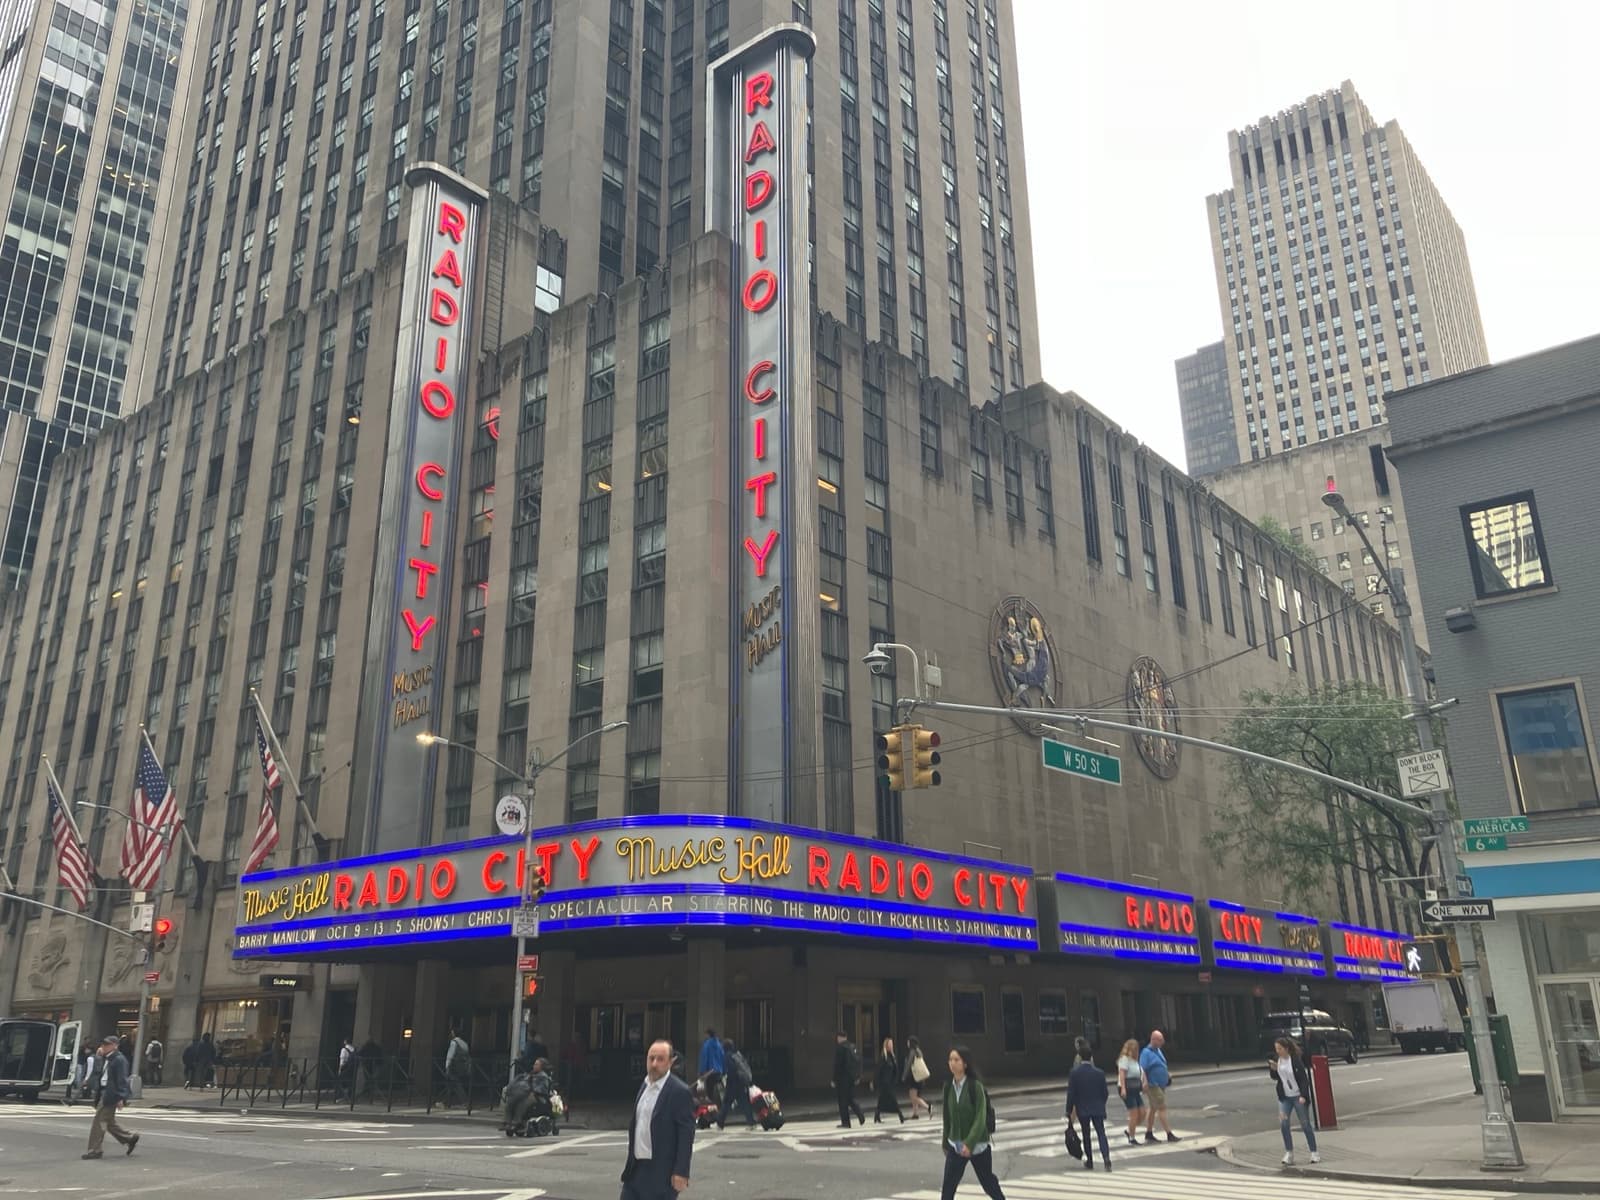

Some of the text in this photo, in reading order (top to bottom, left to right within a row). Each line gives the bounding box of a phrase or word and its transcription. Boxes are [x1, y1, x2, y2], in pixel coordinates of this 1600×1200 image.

[742, 72, 779, 577] RADIO CITY
[401, 202, 466, 651] RADIO CITY
[1063, 750, 1101, 775] W 50 St
[1400, 752, 1441, 767] DON'T BLOCK
[1408, 763, 1436, 774] THE BOX
[1469, 822, 1526, 835] AMERICAS
[1475, 838, 1485, 851] 6
[334, 859, 457, 910] RADIO
[482, 836, 600, 894] CITY
[616, 836, 726, 881] Music
[719, 835, 792, 883] Hall
[808, 845, 934, 901] RADIO
[953, 867, 1029, 914] CITY
[240, 934, 267, 948] BARRY
[272, 929, 317, 945] MANILOW
[326, 925, 349, 940] OCT
[354, 924, 361, 937] 9
[373, 921, 384, 936] 13
[395, 919, 402, 934] 5
[549, 896, 673, 920] SPECTACULAR
[690, 896, 773, 916] STARRING
[782, 899, 805, 919] THE
[813, 903, 850, 922] RADIO
[857, 909, 883, 925] CITY
[890, 912, 950, 932] ROCKETTES
[955, 919, 1000, 936] STARTING
[1003, 924, 1022, 940] NOV
[1126, 895, 1195, 934] RADIO
[1432, 905, 1484, 916] ONE WAY
[1064, 932, 1078, 945] SEE
[1083, 933, 1096, 947] THE
[1220, 911, 1263, 945] CITY
[1344, 931, 1384, 961] RADIO
